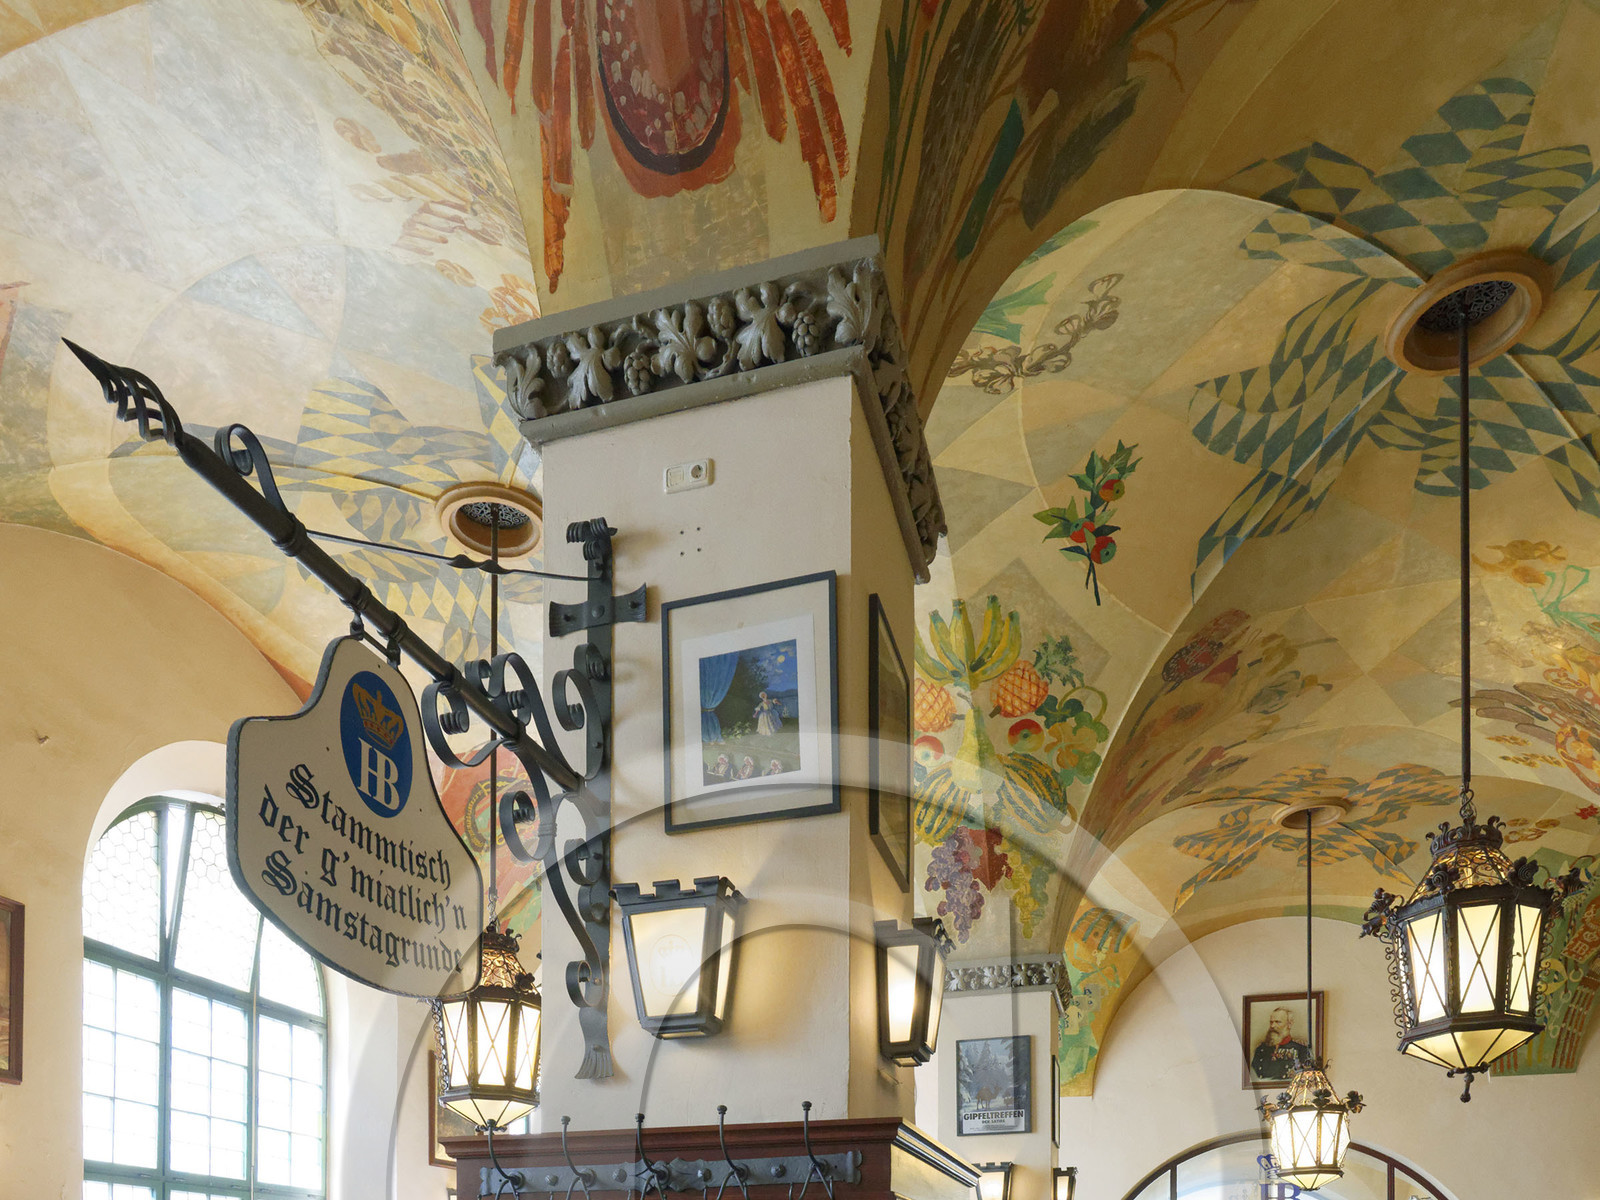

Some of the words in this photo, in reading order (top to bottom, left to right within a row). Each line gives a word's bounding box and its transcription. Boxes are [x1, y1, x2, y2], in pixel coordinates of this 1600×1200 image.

[358, 737, 400, 811] HB
[259, 784, 310, 854] der
[320, 847, 467, 934] g'miatlich'n
[286, 763, 451, 891] Stammtisch
[963, 1110, 1024, 1120] GIPFELTREFFEN
